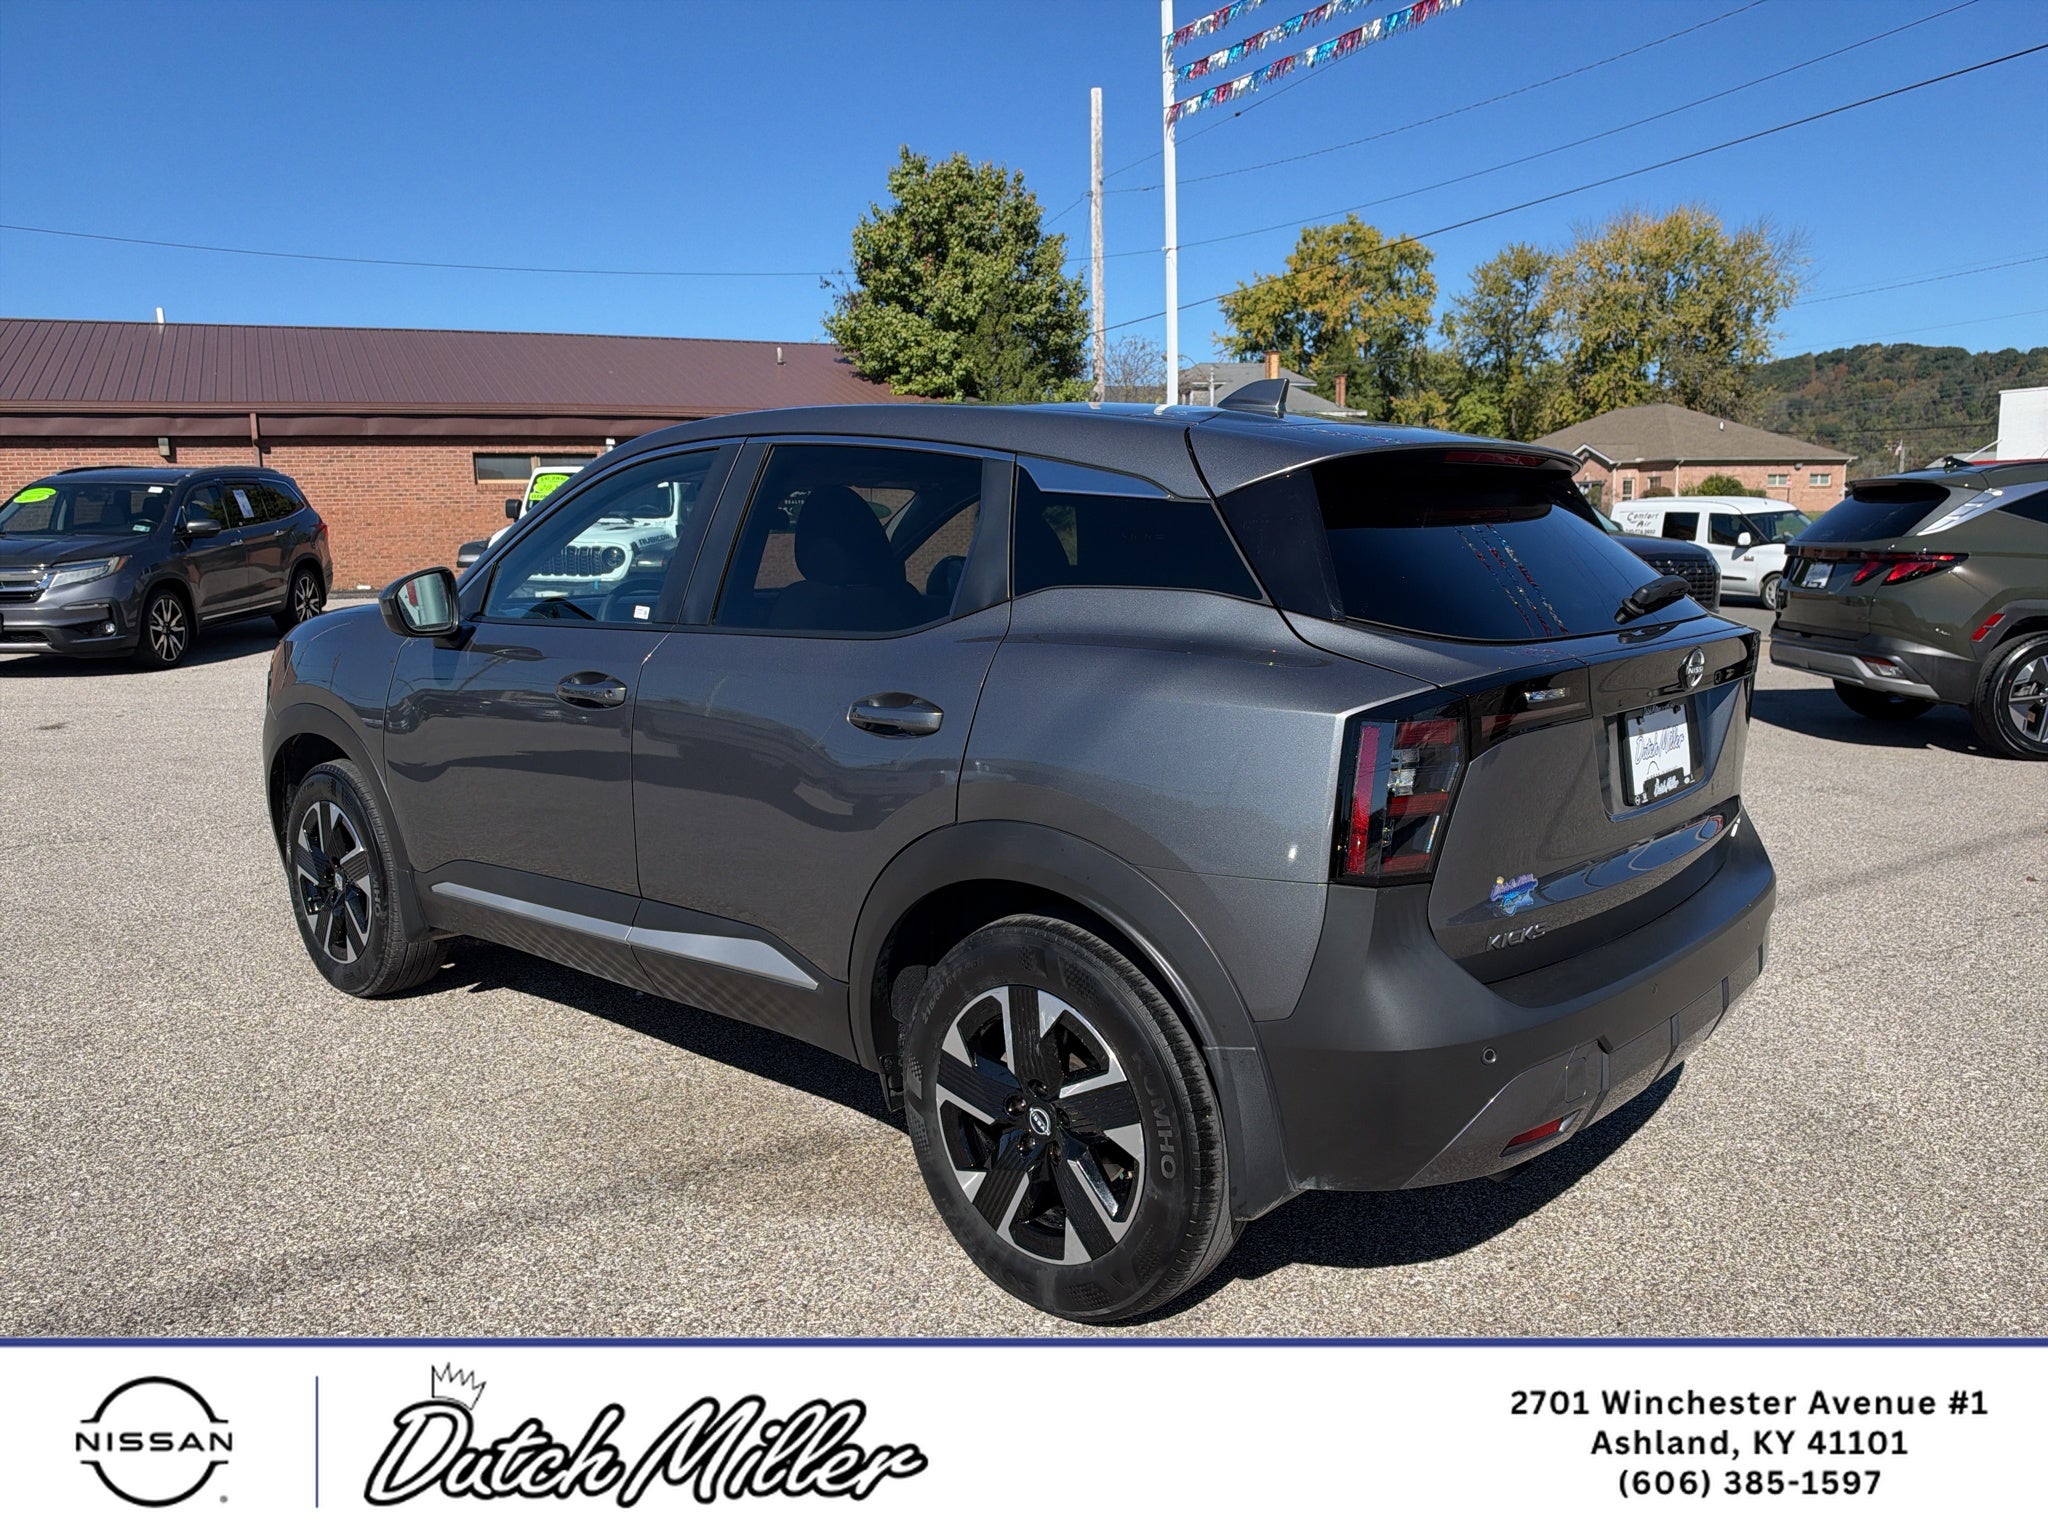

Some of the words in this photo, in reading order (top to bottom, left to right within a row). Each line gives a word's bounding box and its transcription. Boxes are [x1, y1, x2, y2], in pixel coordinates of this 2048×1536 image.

[1626, 511, 1659, 523] Comfort
[1636, 520, 1652, 528] Air
[638, 533, 670, 546] RUBICON
[1635, 732, 1661, 766] Dutch
[1485, 921, 1548, 952] KICKS
